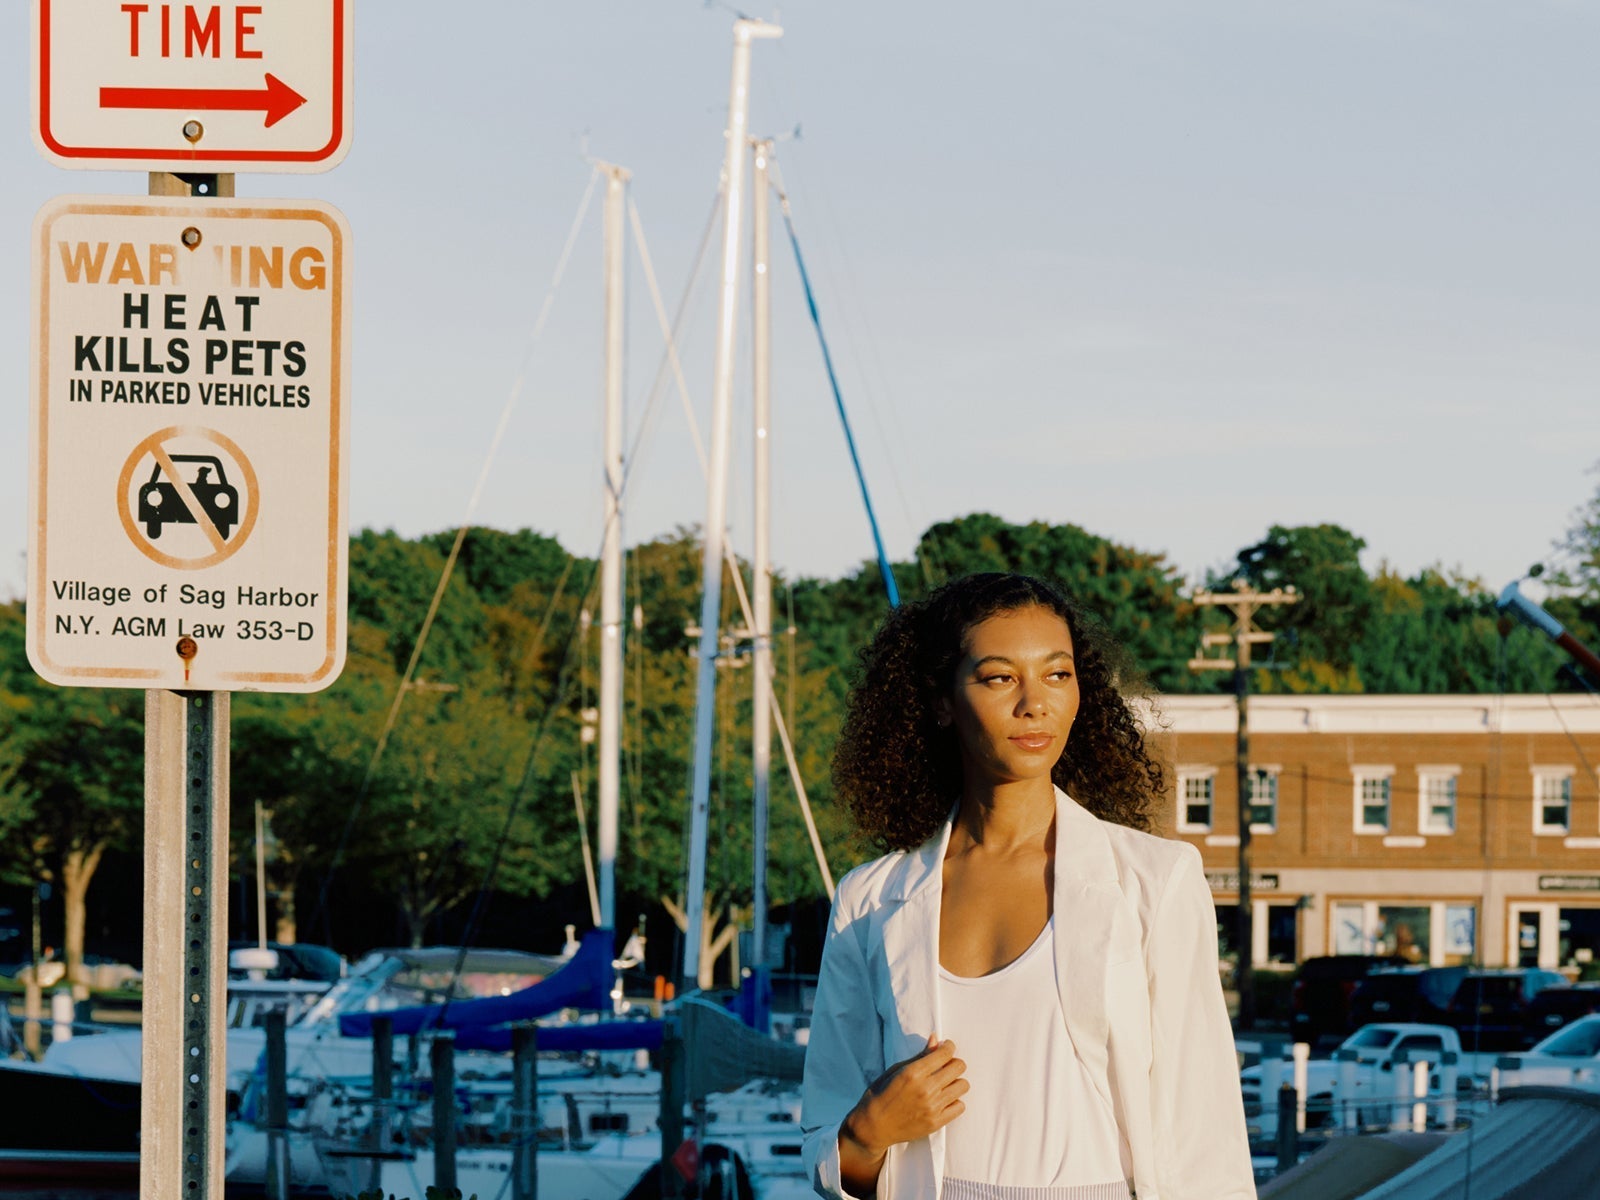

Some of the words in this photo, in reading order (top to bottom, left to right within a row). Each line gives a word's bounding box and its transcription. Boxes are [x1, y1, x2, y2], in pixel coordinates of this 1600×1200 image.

[121, 4, 263, 59] TIME
[58, 242, 327, 290] WARING
[123, 293, 260, 332] HEAT
[74, 335, 190, 374] KILLS
[205, 339, 307, 377] PETS
[69, 379, 92, 402] IN
[101, 380, 191, 405] PARKED
[198, 382, 310, 408] VEHICLES
[52, 580, 131, 606] Village
[143, 584, 167, 602] of
[179, 584, 225, 609] Sag
[238, 586, 319, 607] Harbor
[55, 615, 100, 635] N.Y.
[111, 617, 166, 637] AGM
[178, 618, 225, 639] Law
[236, 620, 314, 641] 353-D
